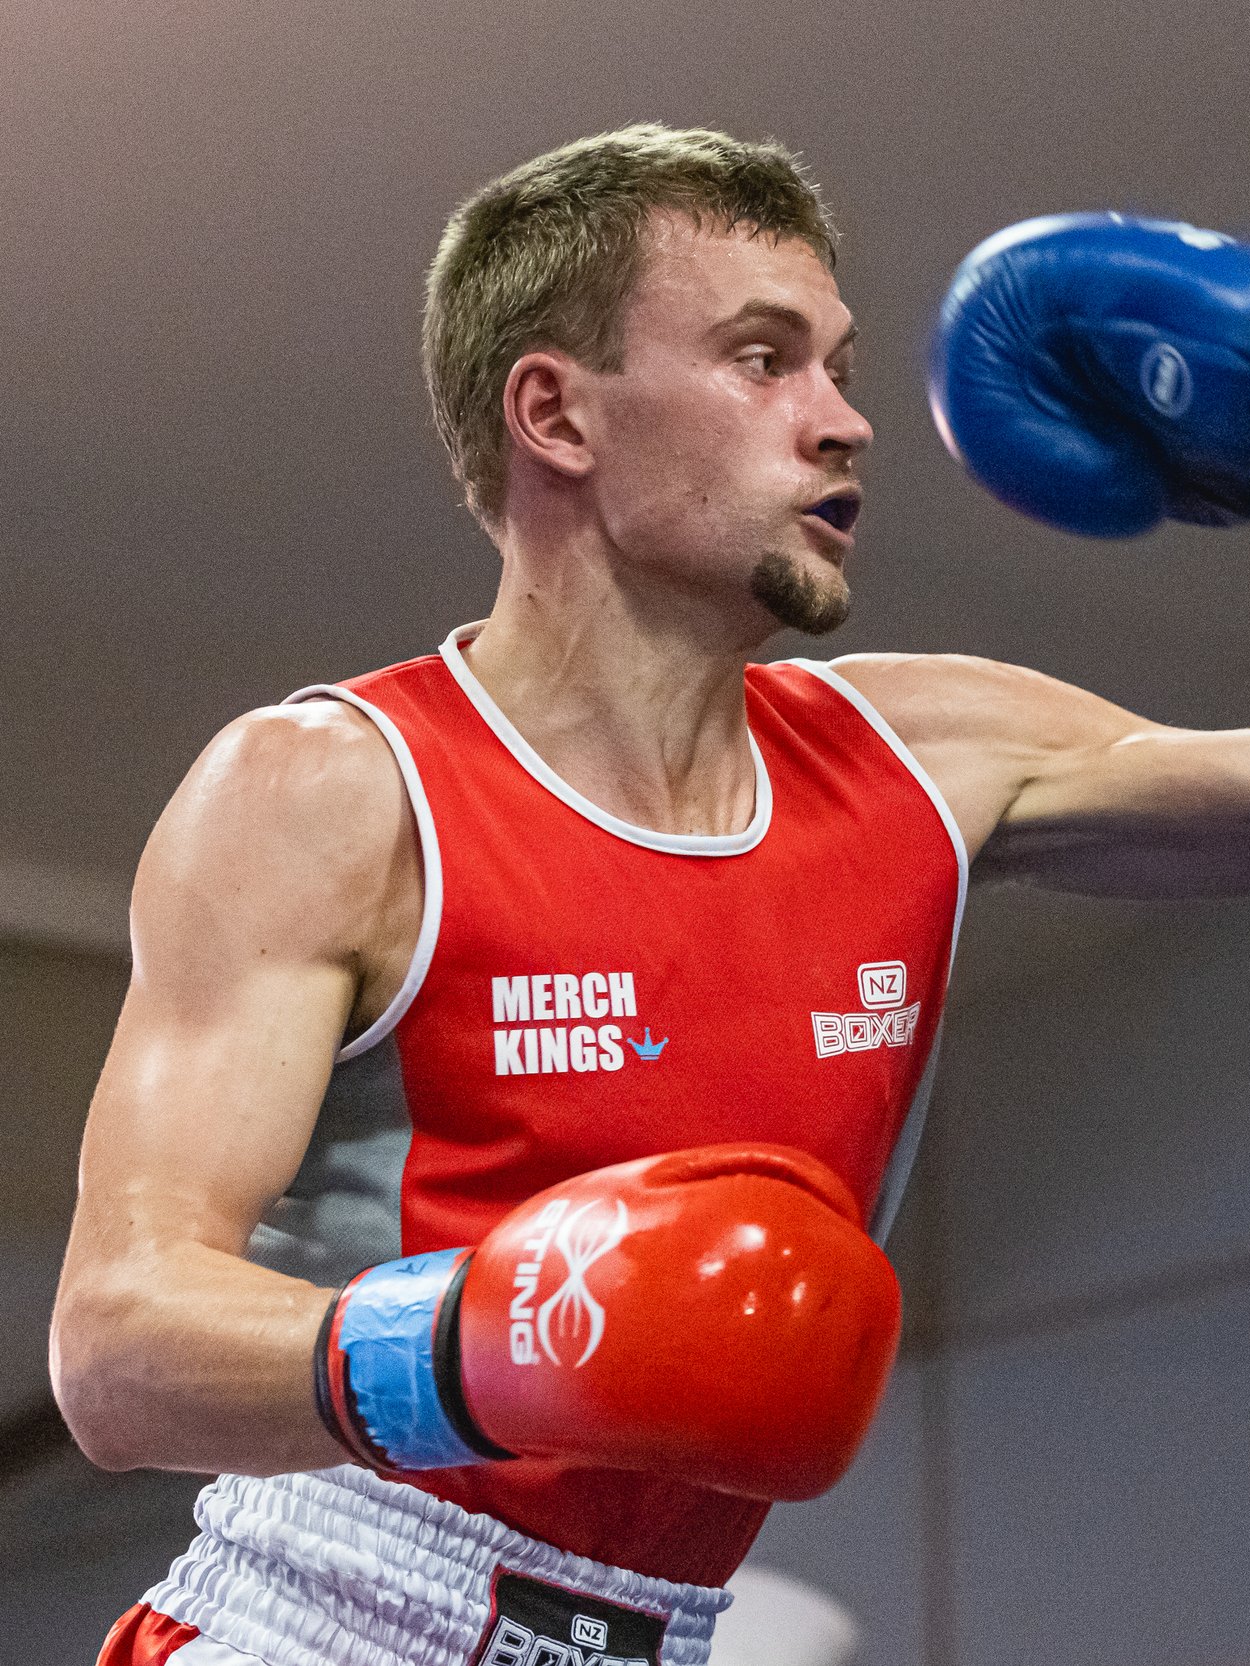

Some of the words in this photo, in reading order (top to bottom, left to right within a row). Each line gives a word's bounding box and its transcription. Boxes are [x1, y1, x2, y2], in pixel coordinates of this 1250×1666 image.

[491, 972, 637, 1022] MERCH
[869, 974, 897, 995] NZ
[493, 1024, 625, 1076] KINGS
[811, 1001, 921, 1059] BOXER
[579, 1623, 602, 1641] NZ
